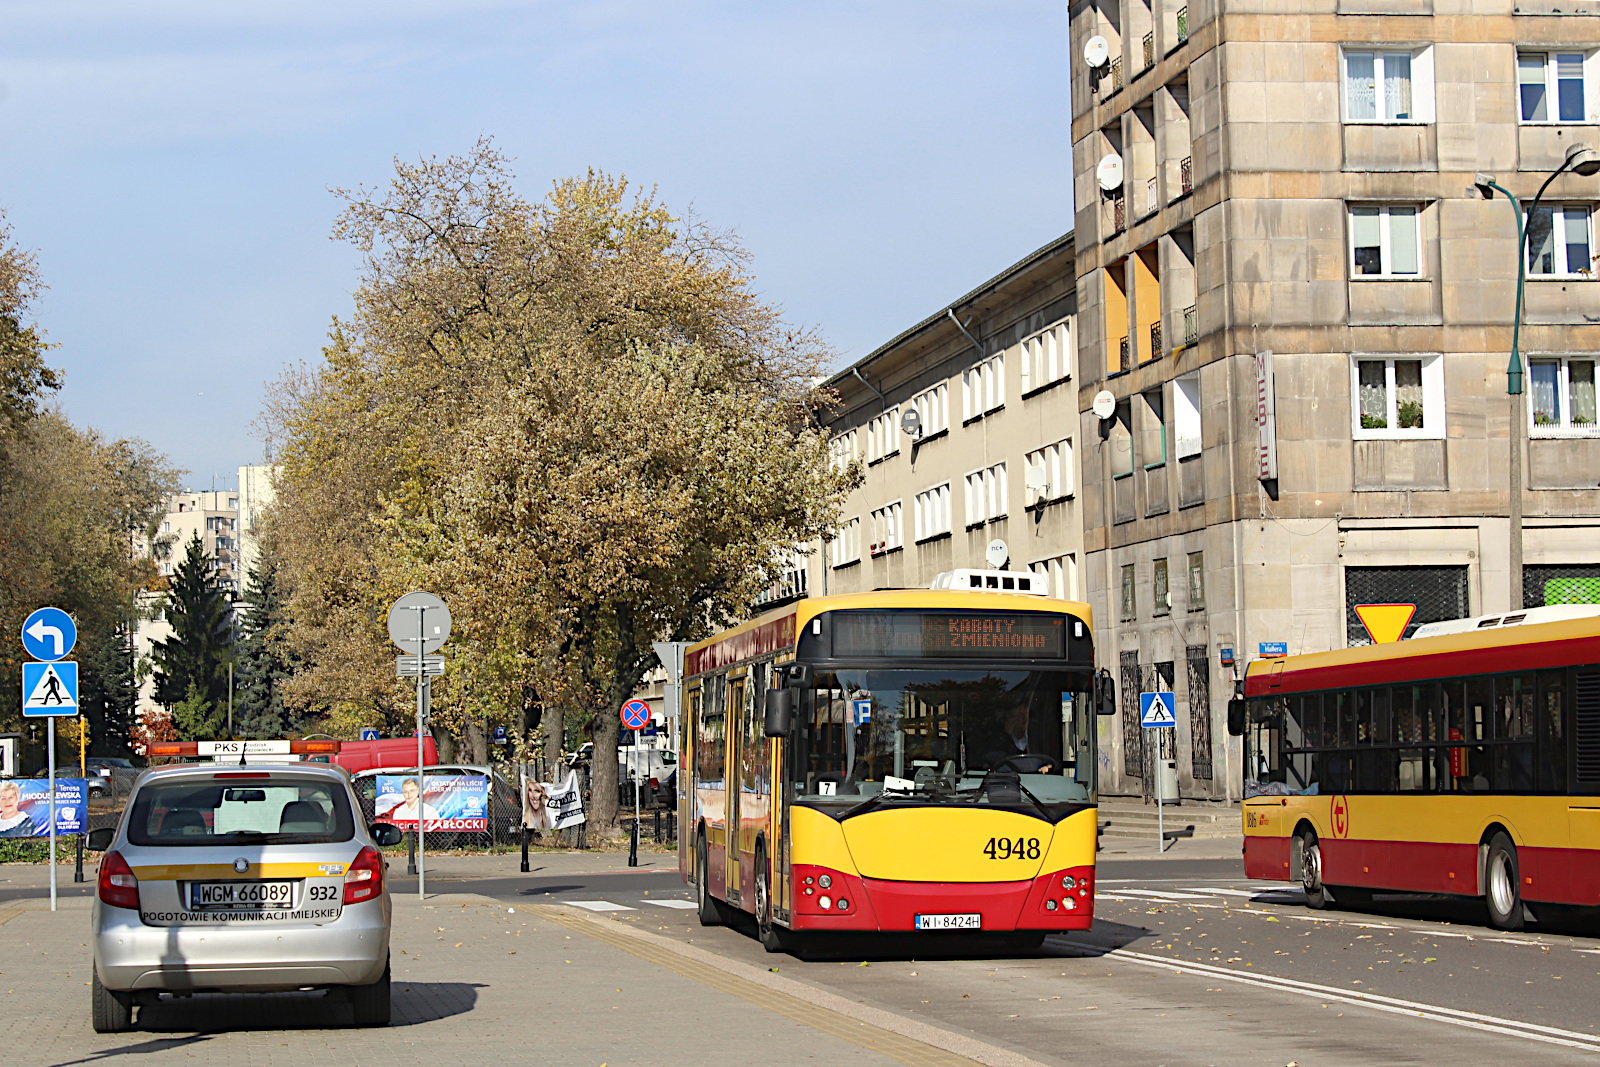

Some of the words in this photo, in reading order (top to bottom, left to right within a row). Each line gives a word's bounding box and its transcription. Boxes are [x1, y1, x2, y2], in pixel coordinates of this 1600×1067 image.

[1256, 355, 1269, 476] MEBLE
[948, 618, 1016, 633] KABATY
[950, 633, 1046, 648] ZMIENIONA
[214, 743, 239, 753] PKS
[22, 791, 81, 800] MIODUSEWSKA
[824, 783, 831, 795] 7
[427, 819, 484, 829] ZABŁOCKI
[983, 837, 1041, 860] 4948
[201, 885, 233, 902] WGM
[238, 884, 289, 901] 66089
[310, 886, 338, 901] 932
[143, 912, 209, 922] POGOTOWIE
[212, 911, 288, 922] KOMUNIKACJI
[290, 908, 341, 920] MIEJSKIEJ
[922, 917, 937, 928] WI
[943, 916, 979, 928] 8424H
